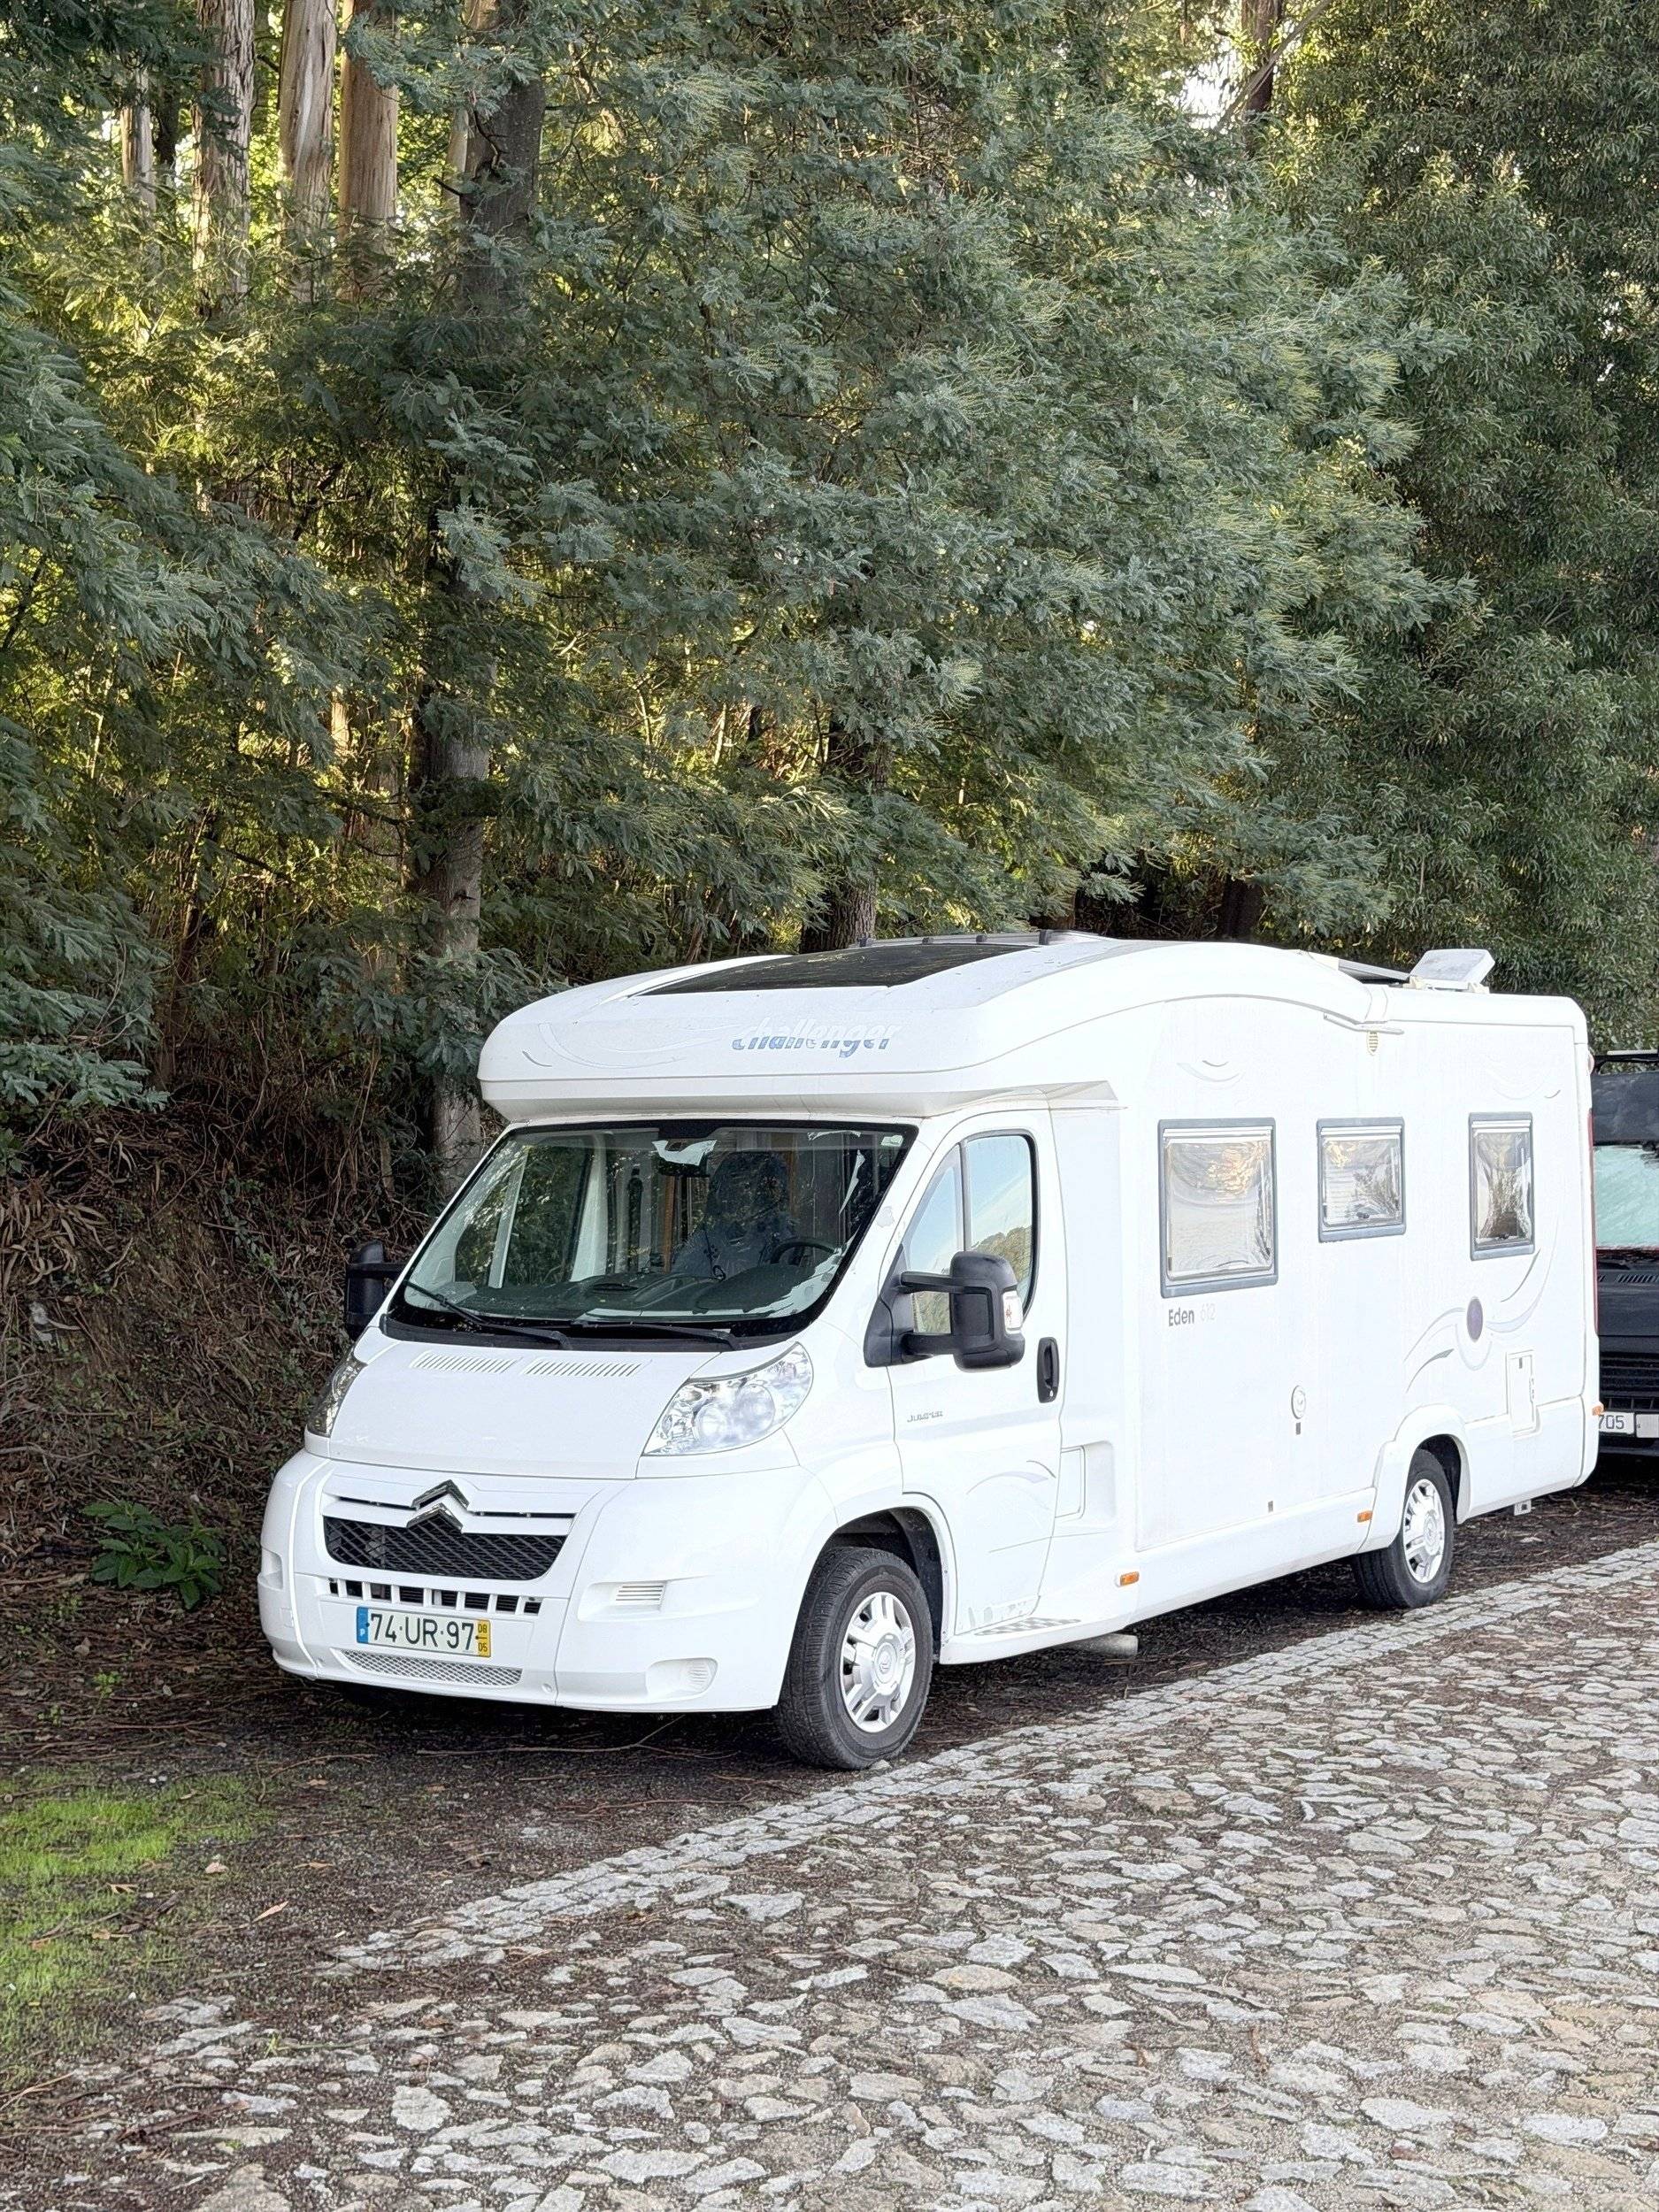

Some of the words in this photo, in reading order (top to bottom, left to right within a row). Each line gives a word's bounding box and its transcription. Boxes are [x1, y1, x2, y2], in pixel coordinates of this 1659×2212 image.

[731, 1017, 902, 1058] challenger
[1168, 1307, 1194, 1326] Eden
[359, 1628, 365, 1637] P
[478, 1623, 488, 1633] 08
[478, 1641, 488, 1652] 05
